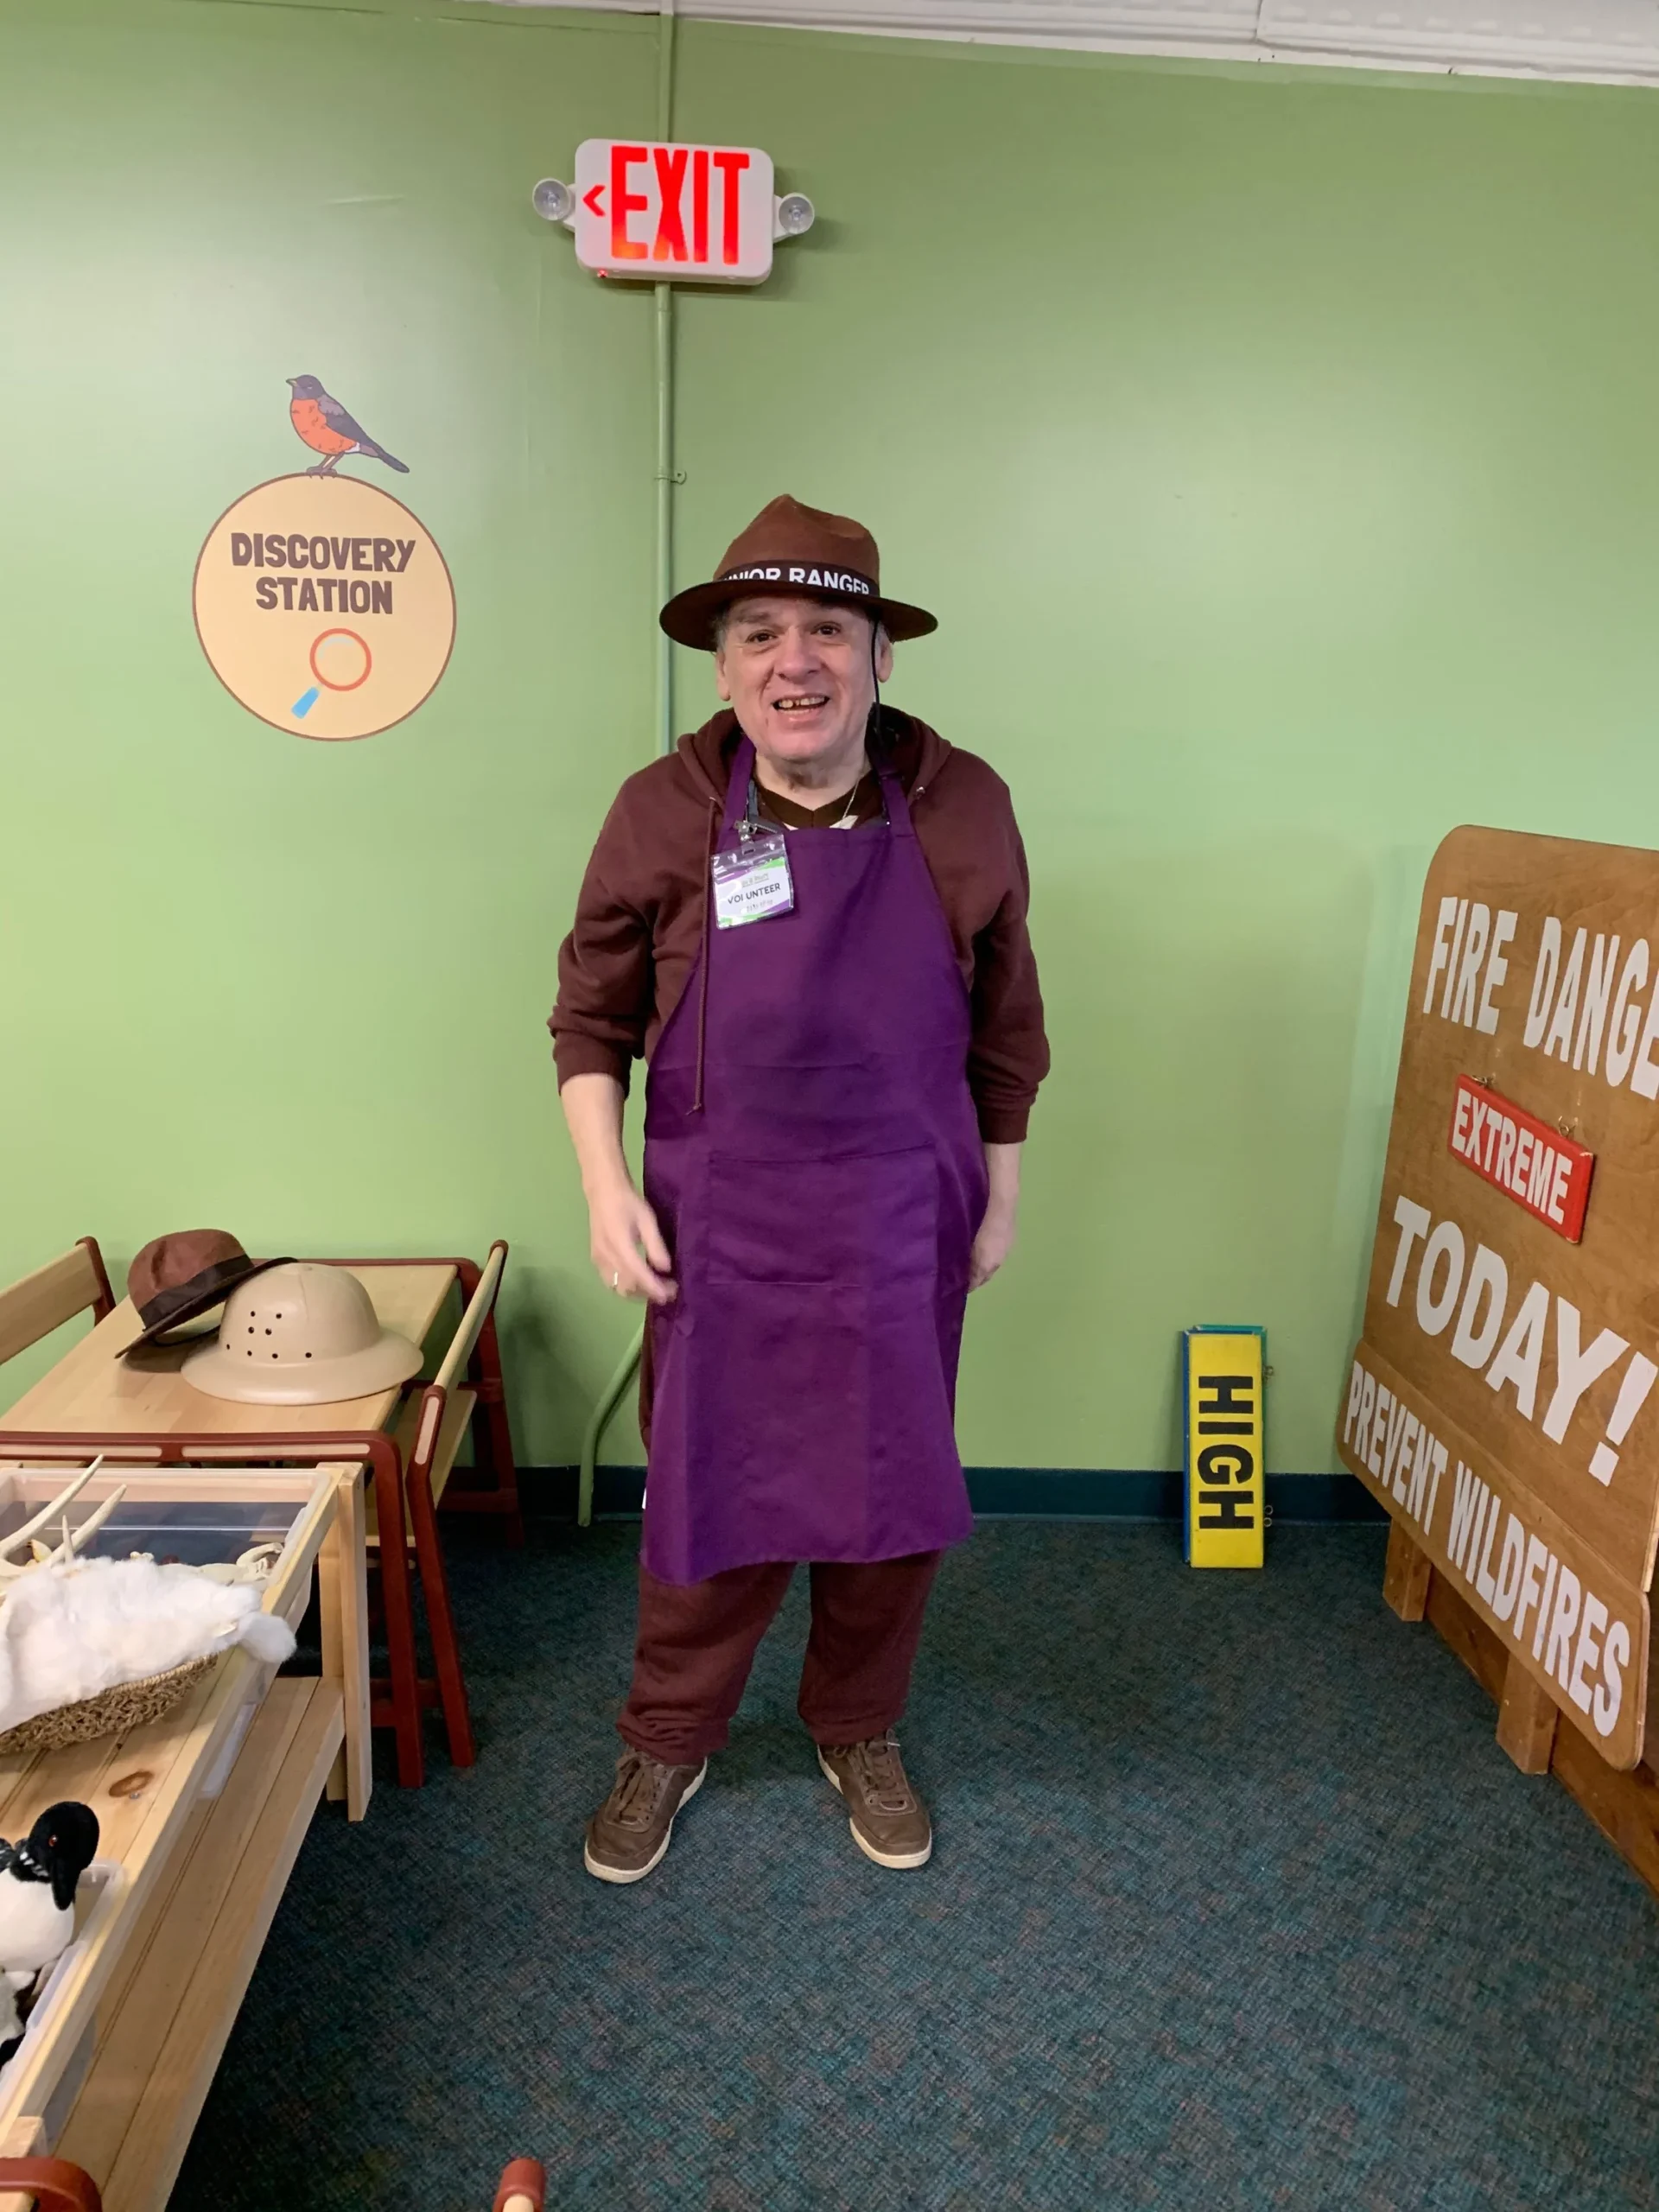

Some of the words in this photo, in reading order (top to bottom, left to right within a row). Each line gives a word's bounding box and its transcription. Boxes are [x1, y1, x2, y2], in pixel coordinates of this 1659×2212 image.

[611, 145, 749, 265] EXIT
[231, 532, 416, 573] DISCOVERY
[256, 576, 393, 614] STATION
[789, 567, 869, 595] RANGER
[1423, 897, 1518, 1035] FIRE
[1452, 1088, 1573, 1225] EXTREME
[1386, 1195, 1658, 1487] TODAY!
[1198, 1376, 1254, 1529] HIGH
[1344, 1360, 1448, 1536] PREVENT
[1447, 1460, 1630, 1737] WILDFIRES
